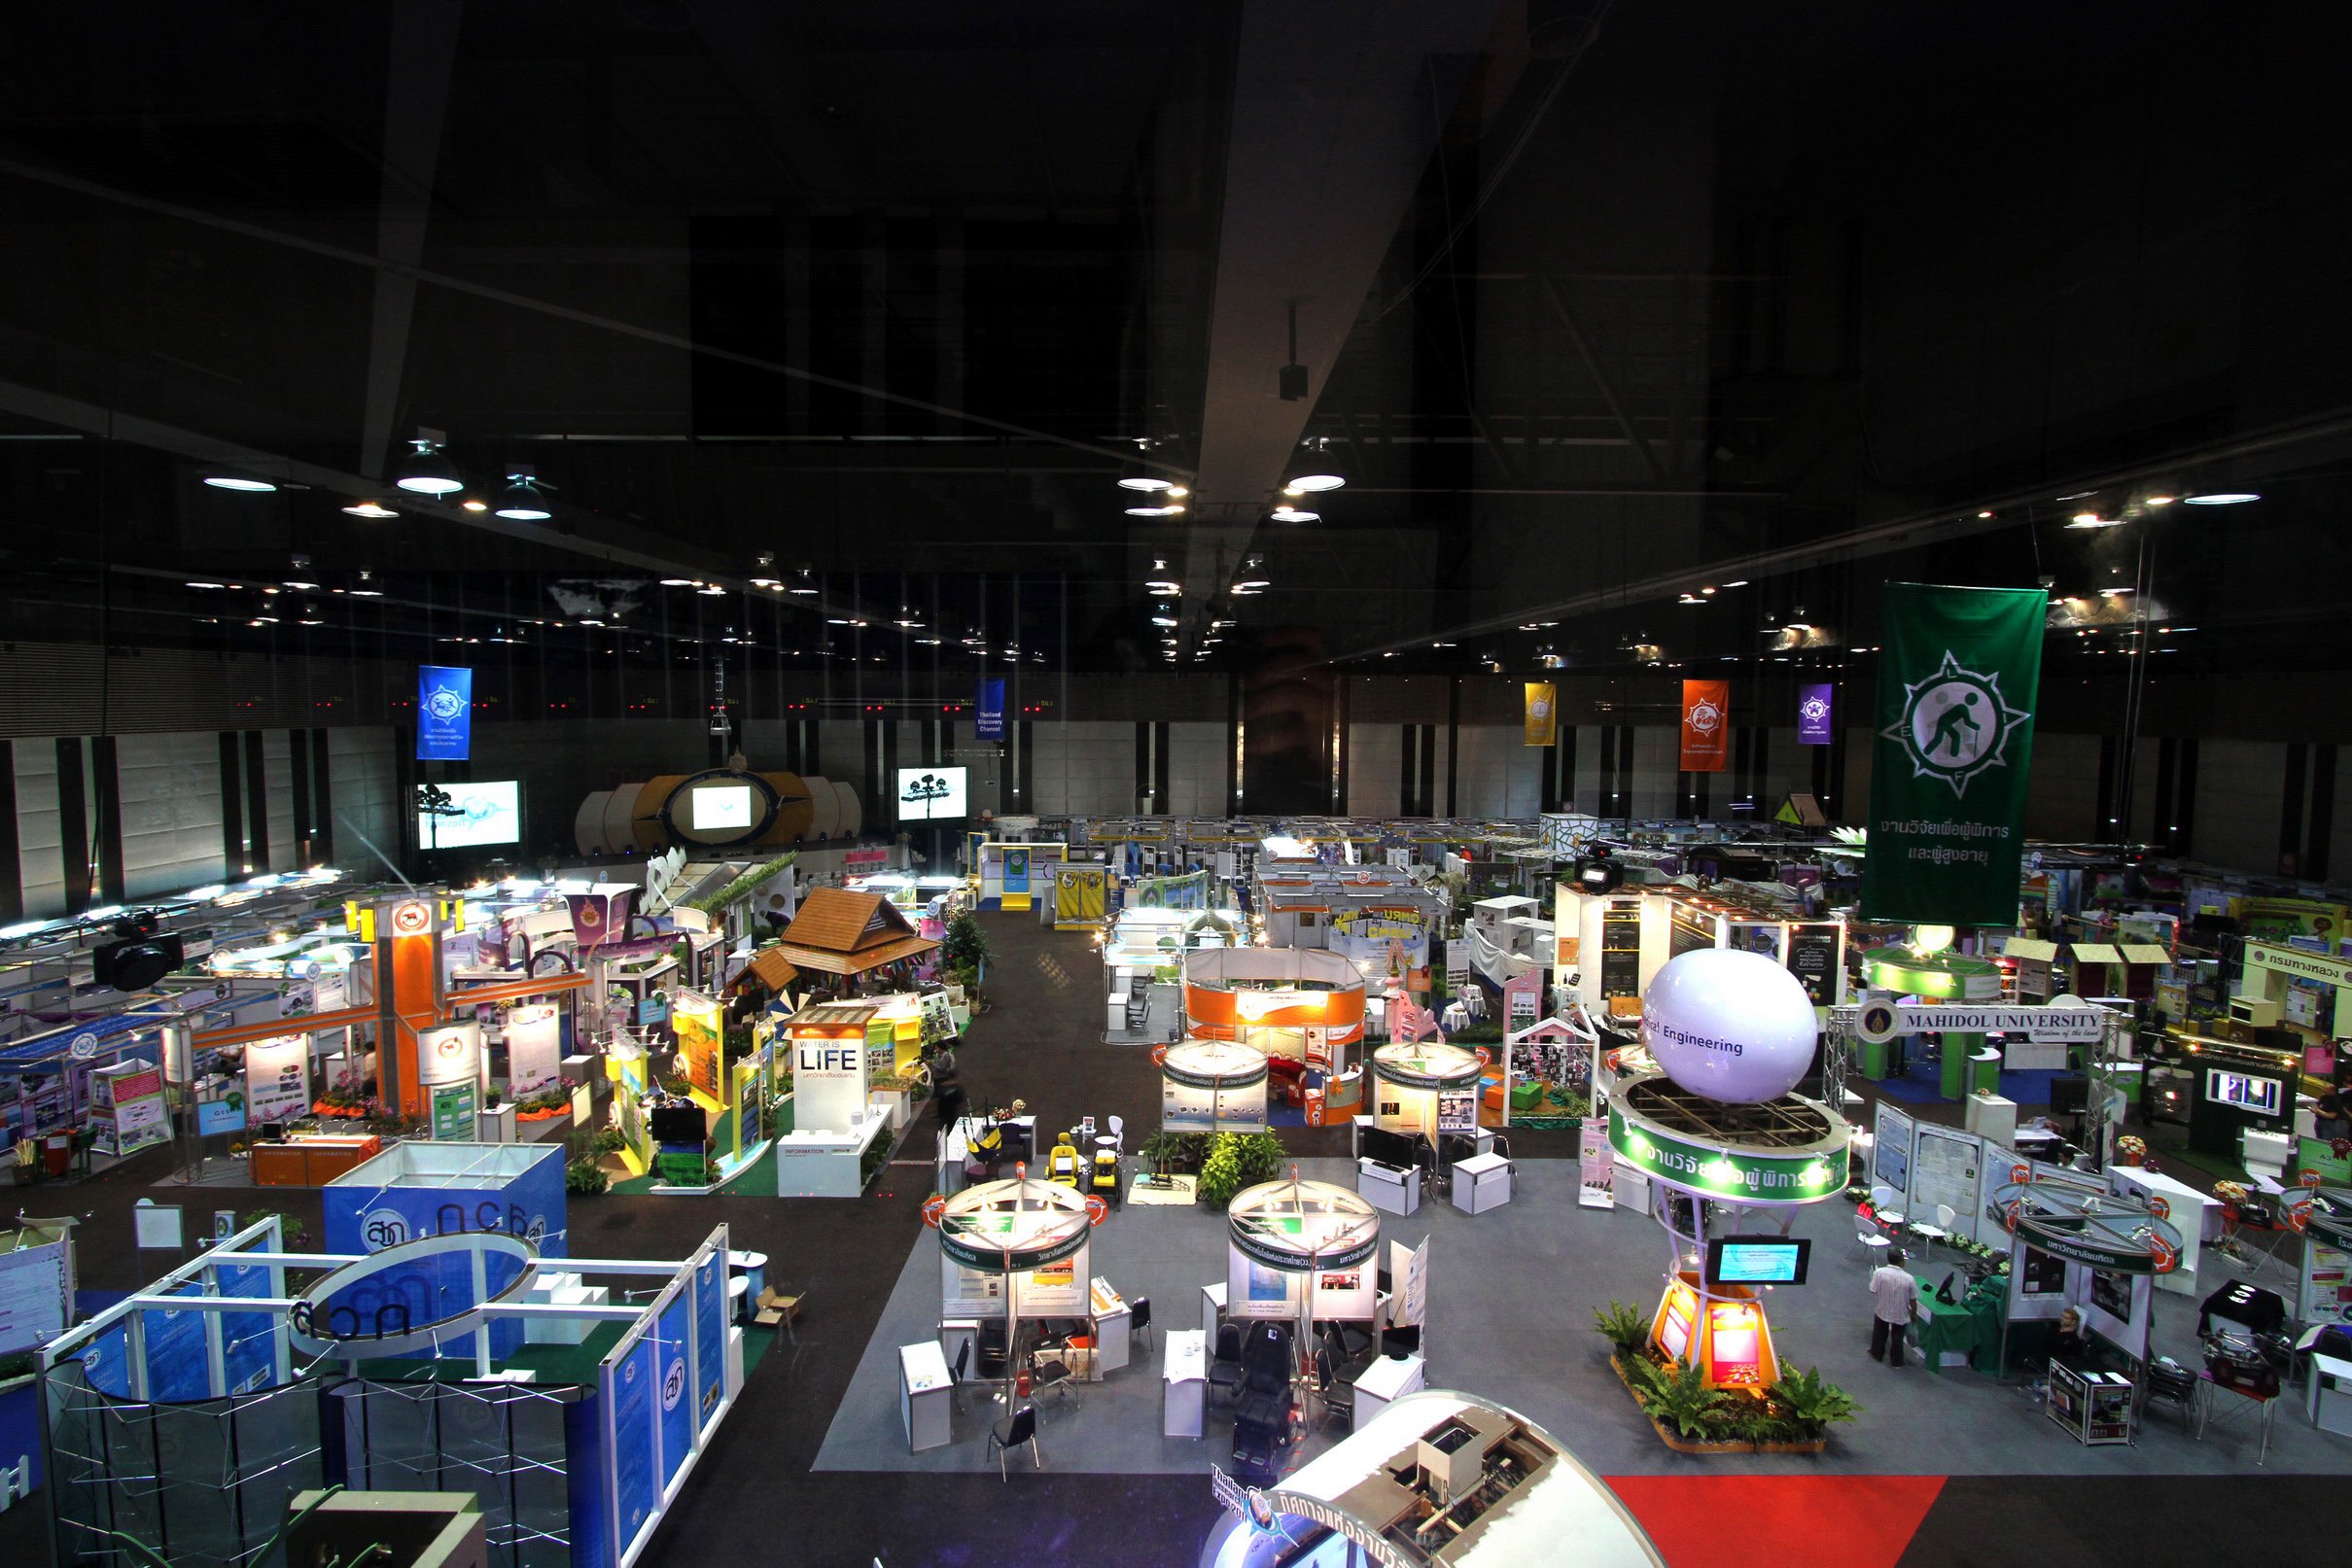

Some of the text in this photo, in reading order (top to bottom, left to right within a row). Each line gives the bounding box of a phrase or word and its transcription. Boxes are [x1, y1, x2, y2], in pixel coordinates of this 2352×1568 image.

[1881, 818, 2010, 841] งานวิจัยเพื่อผู้พิการ
[1908, 845, 1989, 867] และผู้สูงอายุ
[2269, 955, 2339, 978] กรมทางหลวง
[1907, 1014, 2100, 1028] MAHIDOL UNIVERSITY
[1664, 1026, 1743, 1057] Engineering
[2063, 1028, 2071, 1038] of
[800, 1050, 857, 1070] LIFE
[2048, 1240, 2116, 1264] มหาวิทยาลัยมหิดล
[1212, 1466, 1248, 1500] Thailand
[1212, 1478, 1244, 1508] Research
